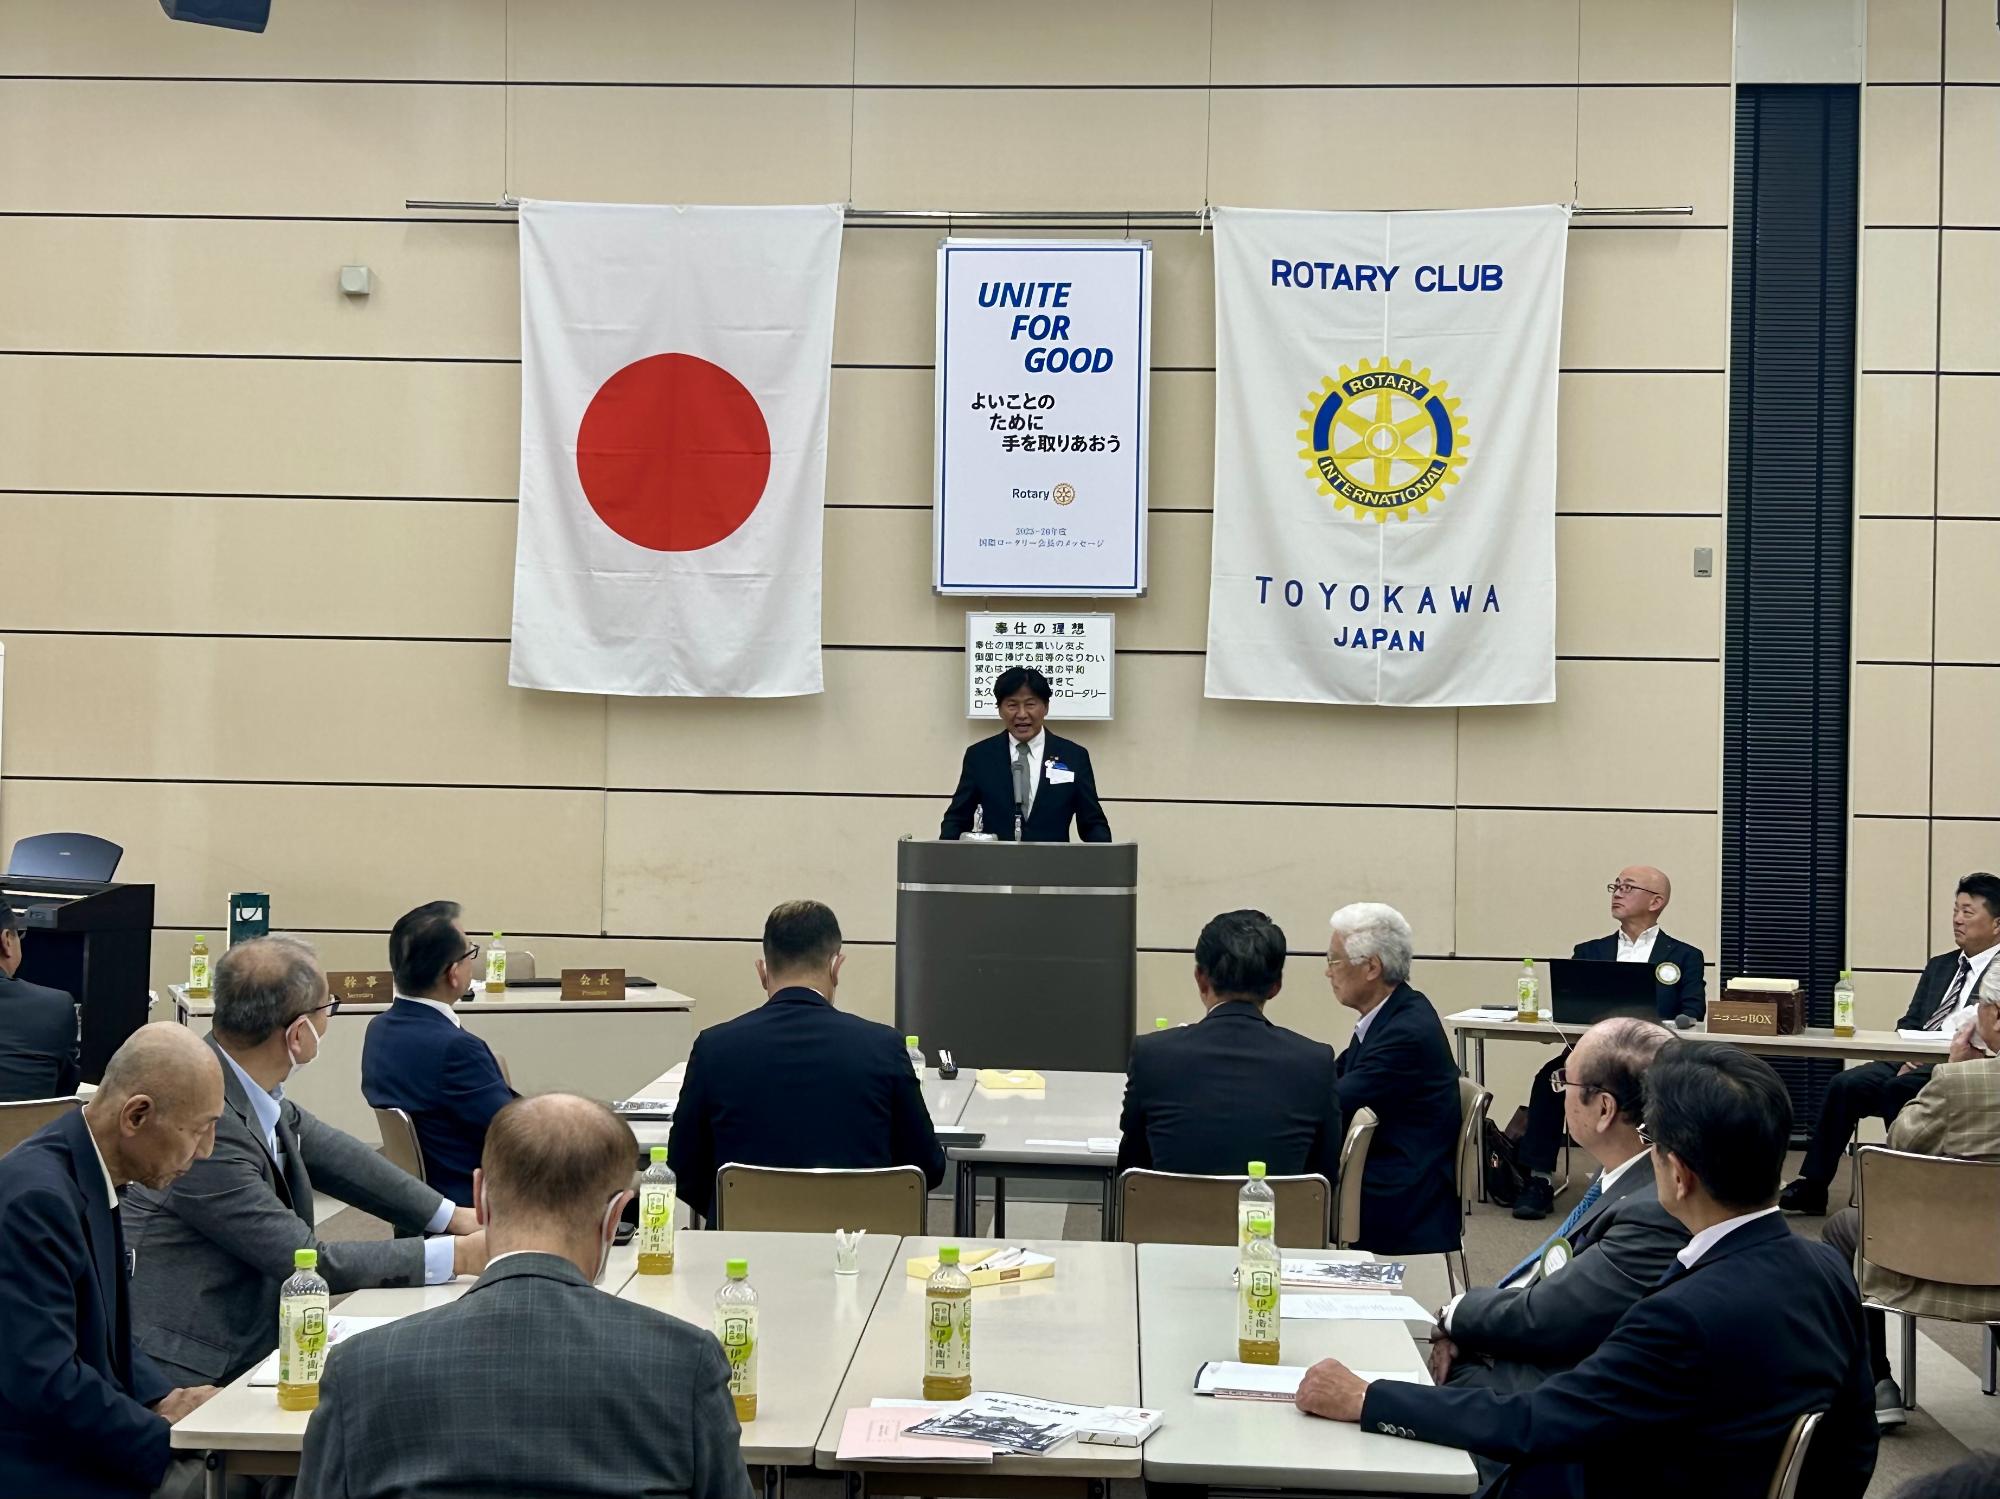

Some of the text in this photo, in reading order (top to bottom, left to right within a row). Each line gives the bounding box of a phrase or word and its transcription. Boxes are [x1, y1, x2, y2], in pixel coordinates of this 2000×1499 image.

[1272, 259, 1504, 293] ROTARY CLUB
[978, 282, 1072, 308] UNITE
[1010, 314, 1071, 341] FOR
[1024, 347, 1114, 373] GOOD
[1349, 374, 1423, 395] ROTARY
[971, 392, 1056, 411] よいことの
[989, 413, 1044, 431] ために
[1001, 434, 1121, 454] 手を取りあおう
[1012, 487, 1050, 502] Rotary
[1320, 459, 1445, 505] INTERNATIONAL
[1256, 576, 1500, 614] TOYOKAWA
[1334, 627, 1425, 652] JAPAN
